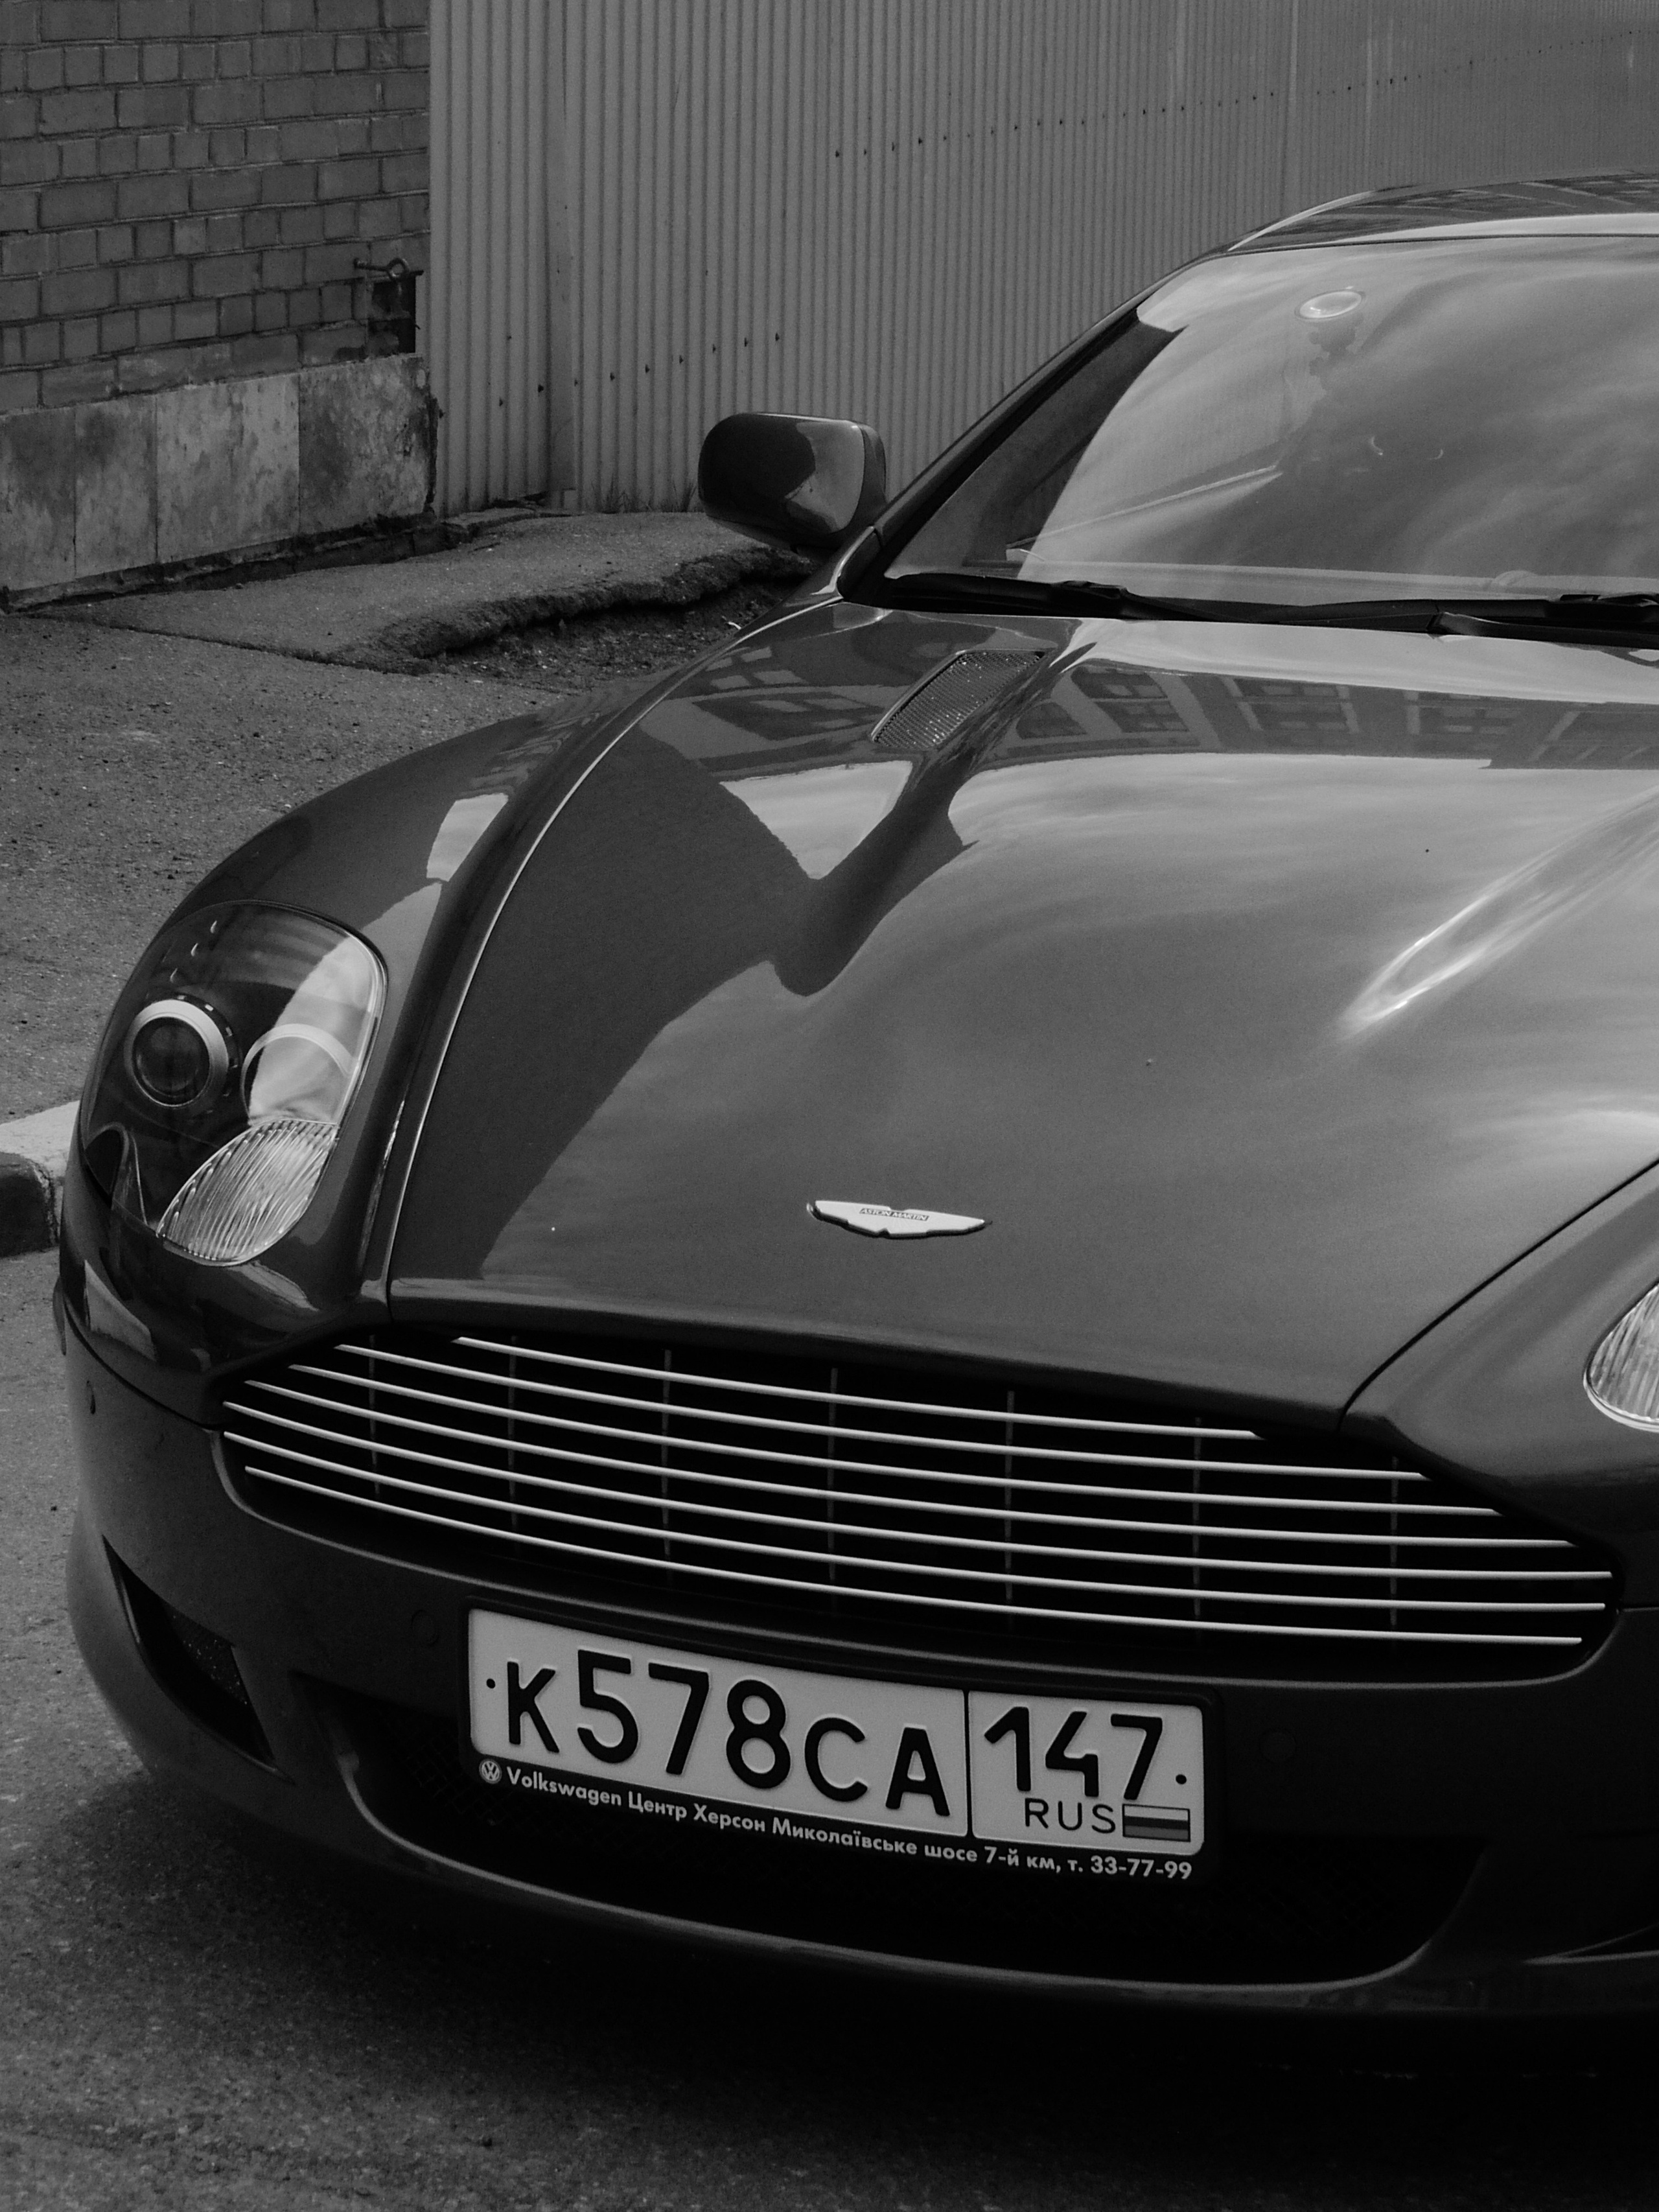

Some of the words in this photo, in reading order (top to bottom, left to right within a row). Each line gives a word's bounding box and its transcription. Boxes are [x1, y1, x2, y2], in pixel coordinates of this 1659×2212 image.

[861, 1208, 890, 1217] ASTON
[892, 1212, 927, 1220] MARTIN
[984, 1706, 1163, 1802] 147
[506, 1766, 621, 1806] Volkswagen
[628, 1791, 688, 1822] Центр
[693, 1803, 765, 1832] Херсон
[772, 1817, 918, 1855] Миколаївське
[924, 1845, 977, 1862] шосе
[984, 1846, 1019, 1867] 7-й
[1027, 1856, 1061, 1873] км,
[1067, 1859, 1083, 1872] т.
[1091, 1855, 1192, 1880] 33-77-99
[1025, 1797, 1116, 1834] RUS
